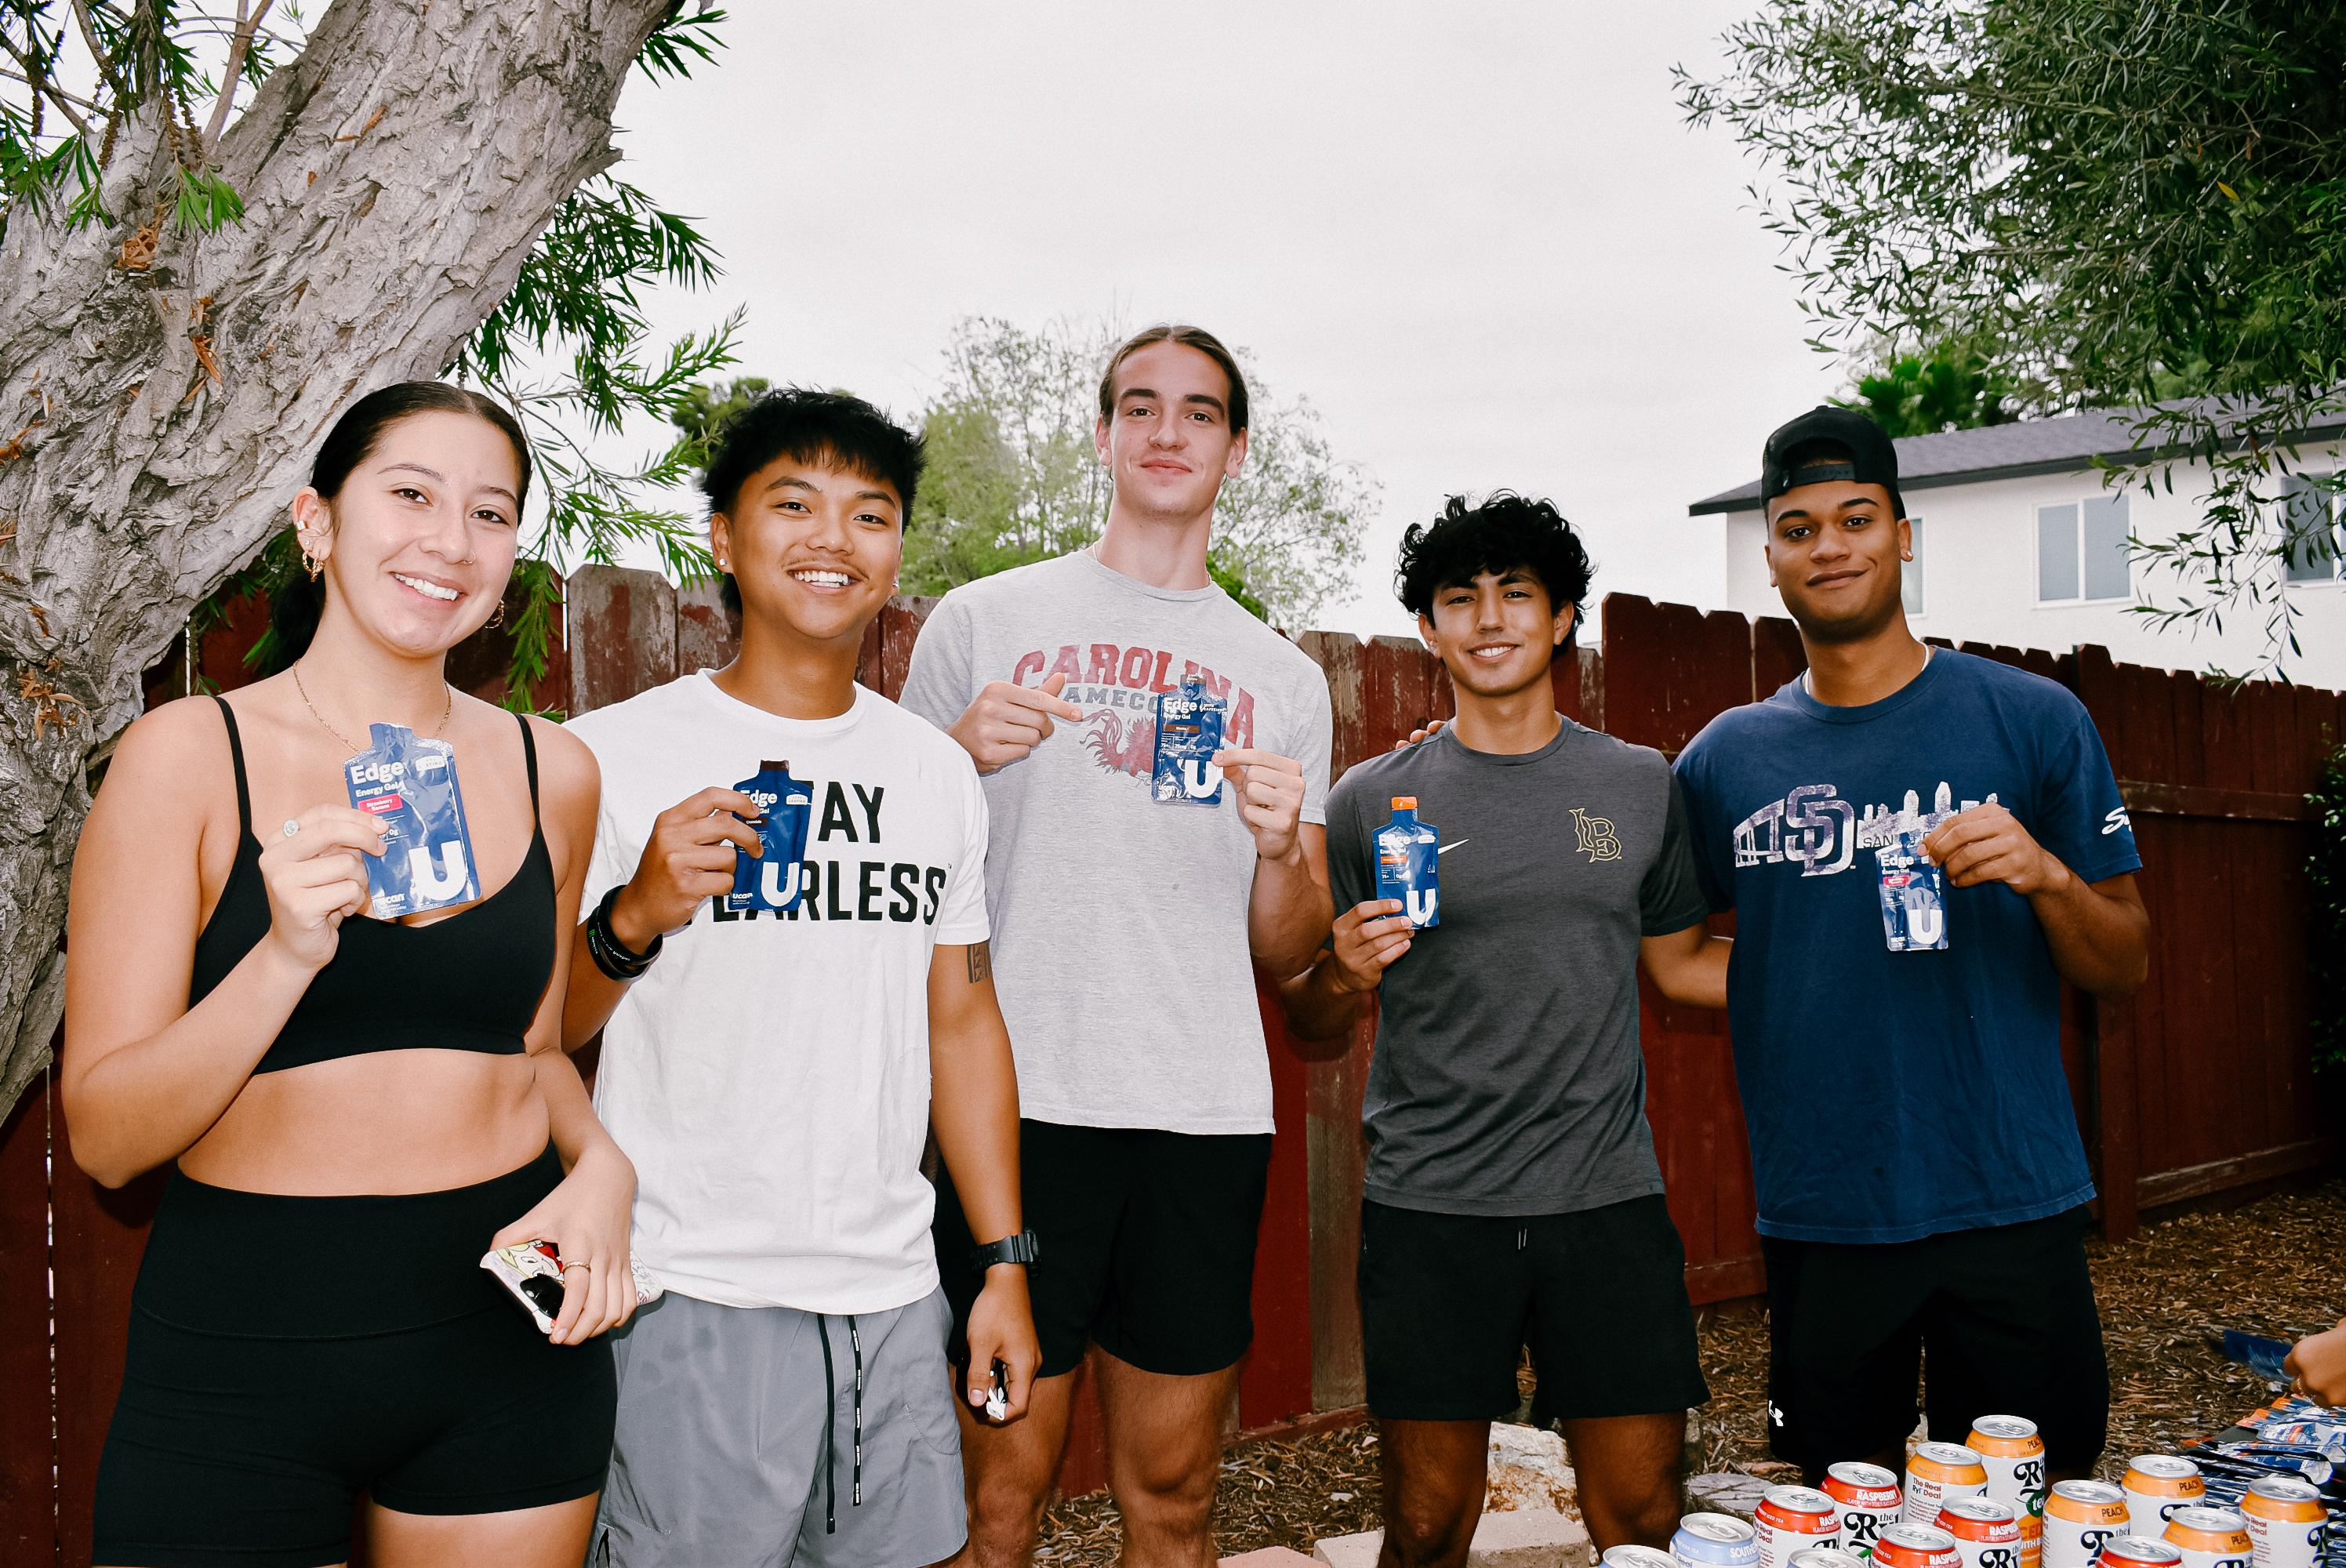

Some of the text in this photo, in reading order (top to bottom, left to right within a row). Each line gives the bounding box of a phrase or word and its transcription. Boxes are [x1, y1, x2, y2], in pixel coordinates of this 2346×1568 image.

[1063, 687, 1158, 714] AMECO
[1164, 698, 1197, 713] Edge
[350, 761, 405, 785] Edge
[1184, 759, 1223, 799] U
[355, 782, 399, 797] Energy Gel
[366, 799, 393, 808] Strawberry
[1378, 833, 1411, 848] Ege
[1881, 855, 1914, 868] Edge
[409, 840, 467, 901] U
[761, 862, 800, 907] U
[381, 894, 405, 906] can
[713, 861, 946, 925] RLESS
[1406, 888, 1436, 925] U
[1908, 909, 1943, 945] U
[2014, 1461, 2045, 1486] Ry
[1913, 1477, 1941, 1491] The Real
[2179, 1479, 2200, 1490] PEACH
[1857, 1489, 1898, 1501] RASPBERRY
[1923, 1489, 1941, 1499] Deal
[1880, 1513, 1893, 1522] the
[2101, 1506, 2125, 1517] PEACH
[1819, 1513, 1839, 1526] RASP
[2251, 1517, 2267, 1527] Real
[1760, 1524, 1773, 1536] Real
[1989, 1522, 2018, 1535] RASPB
[2020, 1523, 2042, 1541] CED
[2250, 1525, 2267, 1536] Deal
[1758, 1533, 1772, 1544] Deal
[2232, 1533, 2250, 1544] PEAC
[1730, 1542, 1757, 1559] SOUTH
[1929, 1550, 1959, 1565] RASPB
